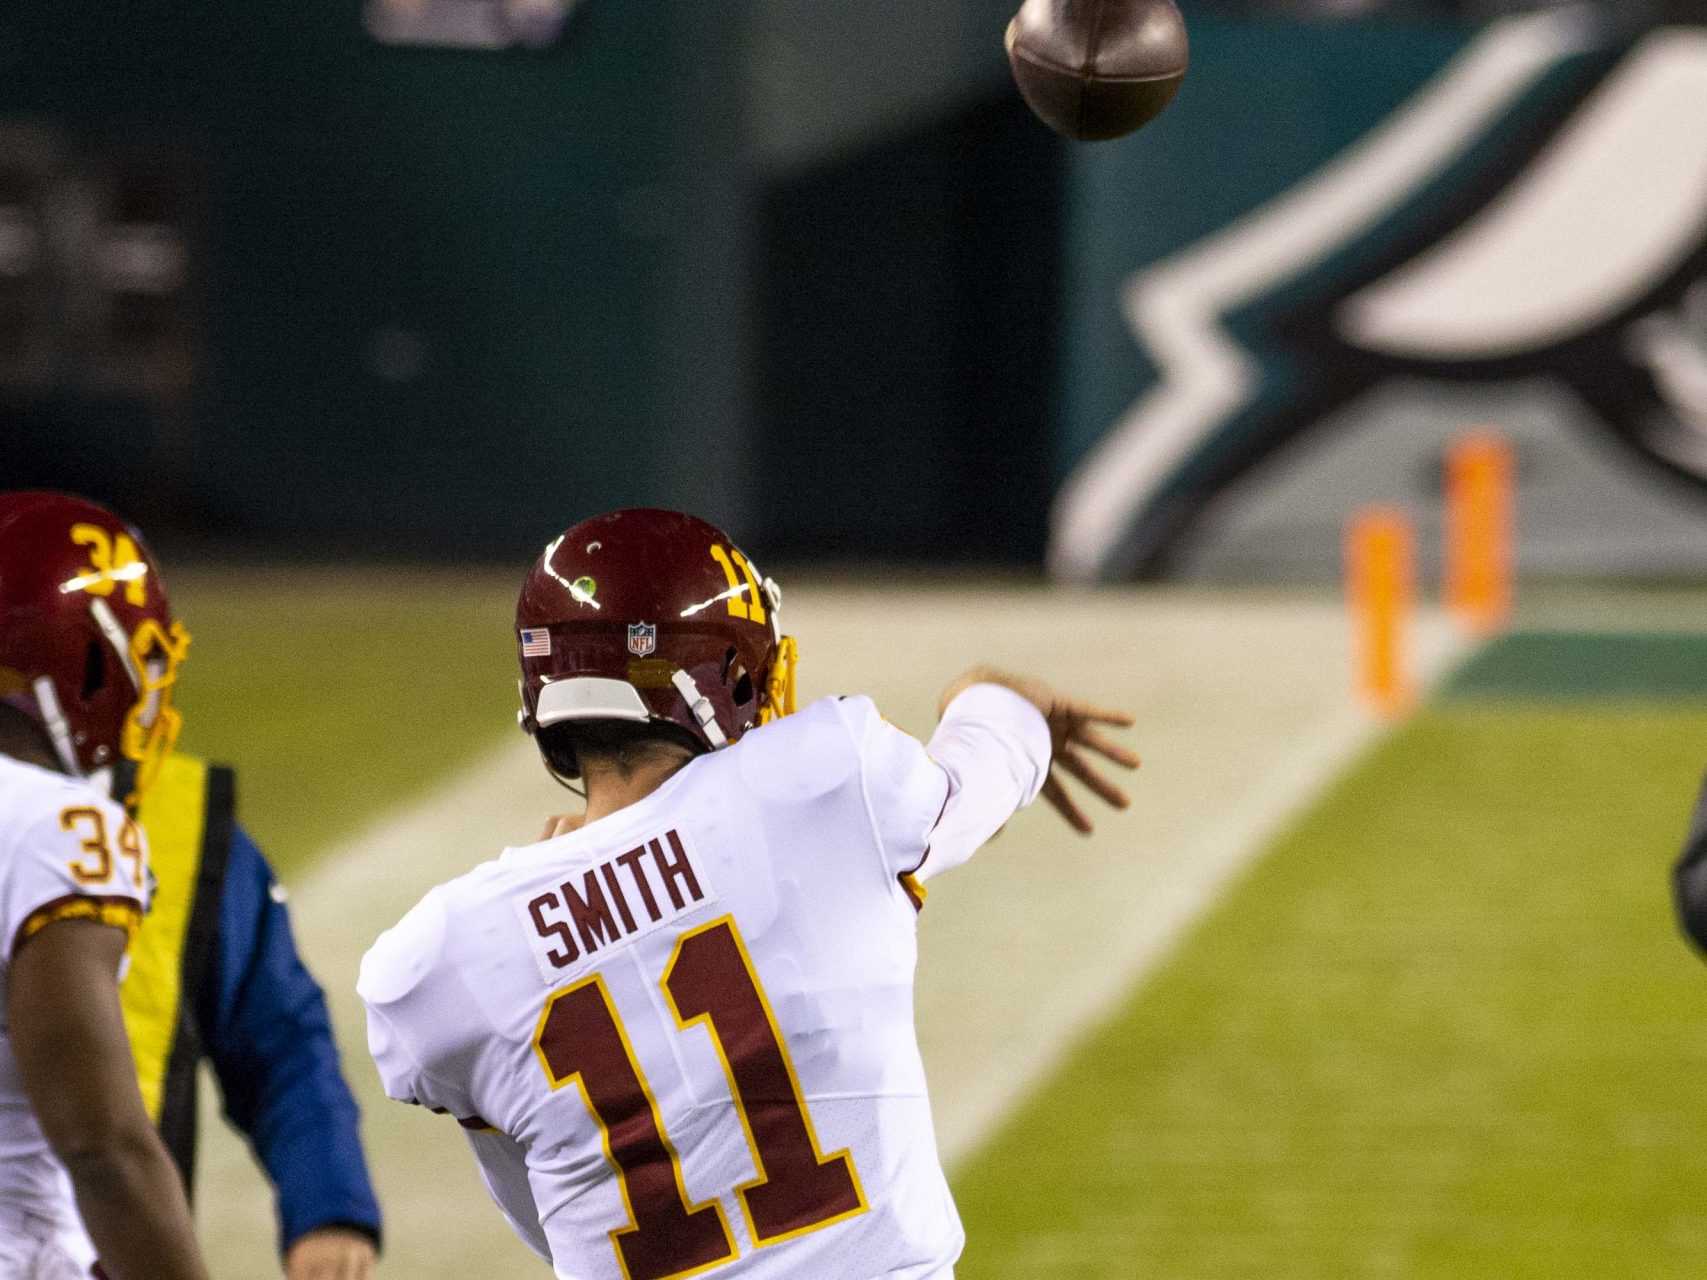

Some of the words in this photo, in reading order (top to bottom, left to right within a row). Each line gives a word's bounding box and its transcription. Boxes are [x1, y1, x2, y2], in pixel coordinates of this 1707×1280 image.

[70, 523, 146, 606] 34
[710, 544, 766, 625] 11
[632, 637, 652, 651] NFL
[60, 806, 145, 888] 34
[528, 829, 704, 969] SMITH
